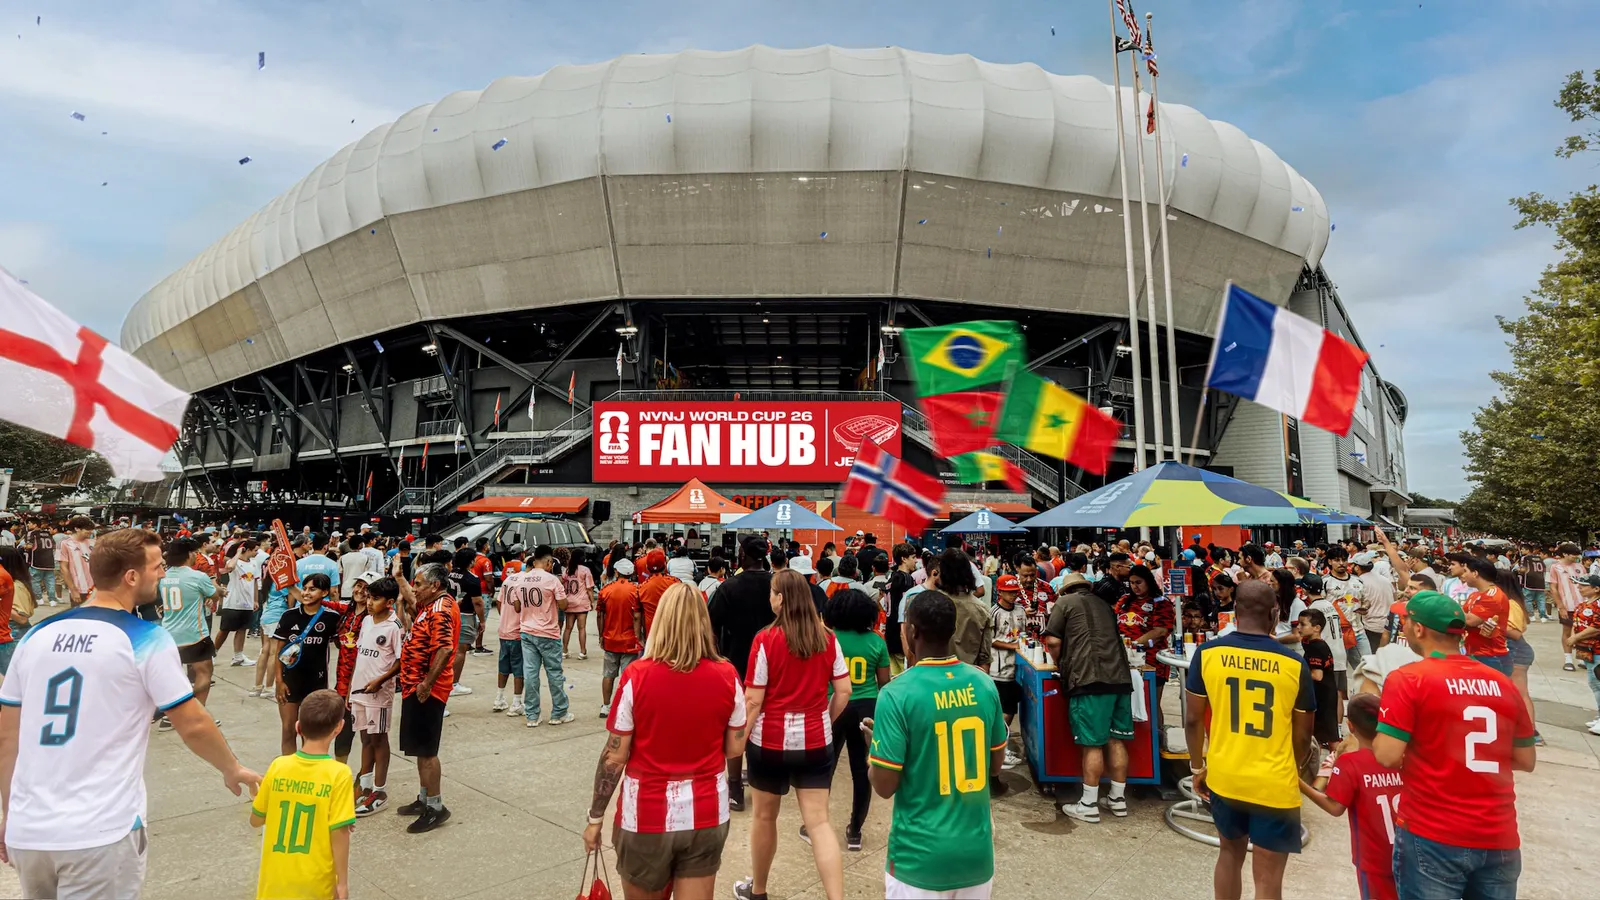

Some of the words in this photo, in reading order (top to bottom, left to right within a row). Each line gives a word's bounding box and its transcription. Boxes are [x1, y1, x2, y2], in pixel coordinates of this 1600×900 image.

[639, 412, 684, 421] NYNJ
[689, 412, 748, 421] WORLD
[752, 412, 786, 421] CUP
[790, 412, 813, 421] 26
[639, 423, 720, 466] FAN
[729, 423, 816, 466] HUB
[834, 456, 855, 467] JE
[40, 538, 53, 549] 10
[1532, 562, 1544, 572] 10
[162, 586, 184, 612] 10
[520, 587, 543, 608] 10
[52, 633, 98, 653] KANE
[1221, 654, 1280, 675] VALENCIA
[934, 682, 978, 710] MANÉ
[1445, 678, 1502, 698] HAKIMI
[39, 665, 84, 746] 9
[1225, 676, 1274, 739] 13
[1463, 705, 1500, 774] 2
[934, 716, 986, 796] 10
[272, 777, 315, 796] NEYMAR
[316, 783, 332, 798] JR
[1363, 772, 1404, 788] PANAM
[272, 800, 317, 855] 10
